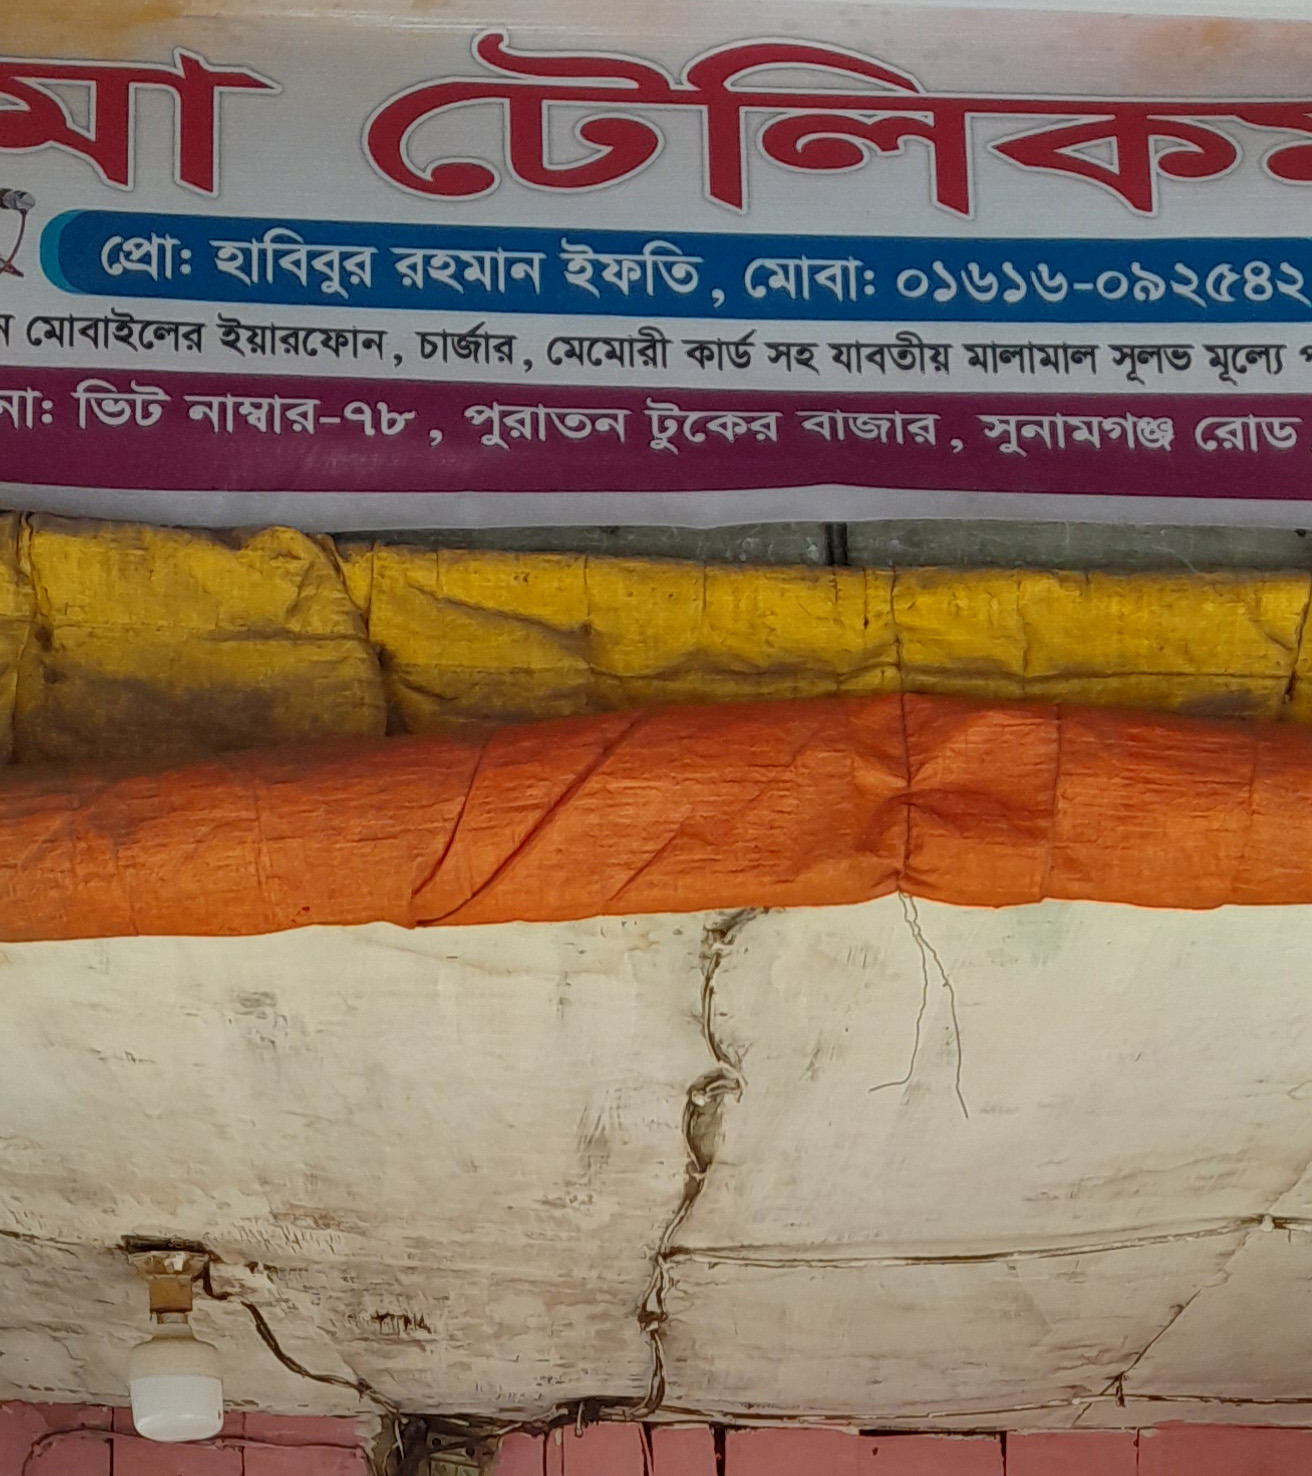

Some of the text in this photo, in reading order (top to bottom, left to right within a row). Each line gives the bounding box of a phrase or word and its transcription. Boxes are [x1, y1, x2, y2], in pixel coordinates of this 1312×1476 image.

[209, 227, 379, 299] হাবিবুর
[389, 246, 547, 295] রহমান
[559, 237, 726, 308] ইফতি,
[896, 259, 1312, 309] ০১৬১৬-০৯২৫৪২
[26, 308, 207, 354] মোবাইলের
[547, 326, 674, 369] মেমোরী
[681, 329, 757, 372] কার্ড
[764, 341, 820, 376] সহ
[828, 330, 953, 375] যাবতীয়
[961, 340, 1100, 375] মালামাল
[1108, 343, 1195, 386] সূলভ
[1202, 343, 1288, 387] মূল্যে
[70, 378, 171, 430] ভিট
[463, 400, 632, 450] পুরাতন
[644, 397, 784, 455] টুকের
[794, 408, 965, 455] বাজার,
[975, 412, 1175, 458] সুনামগঞ্জ
